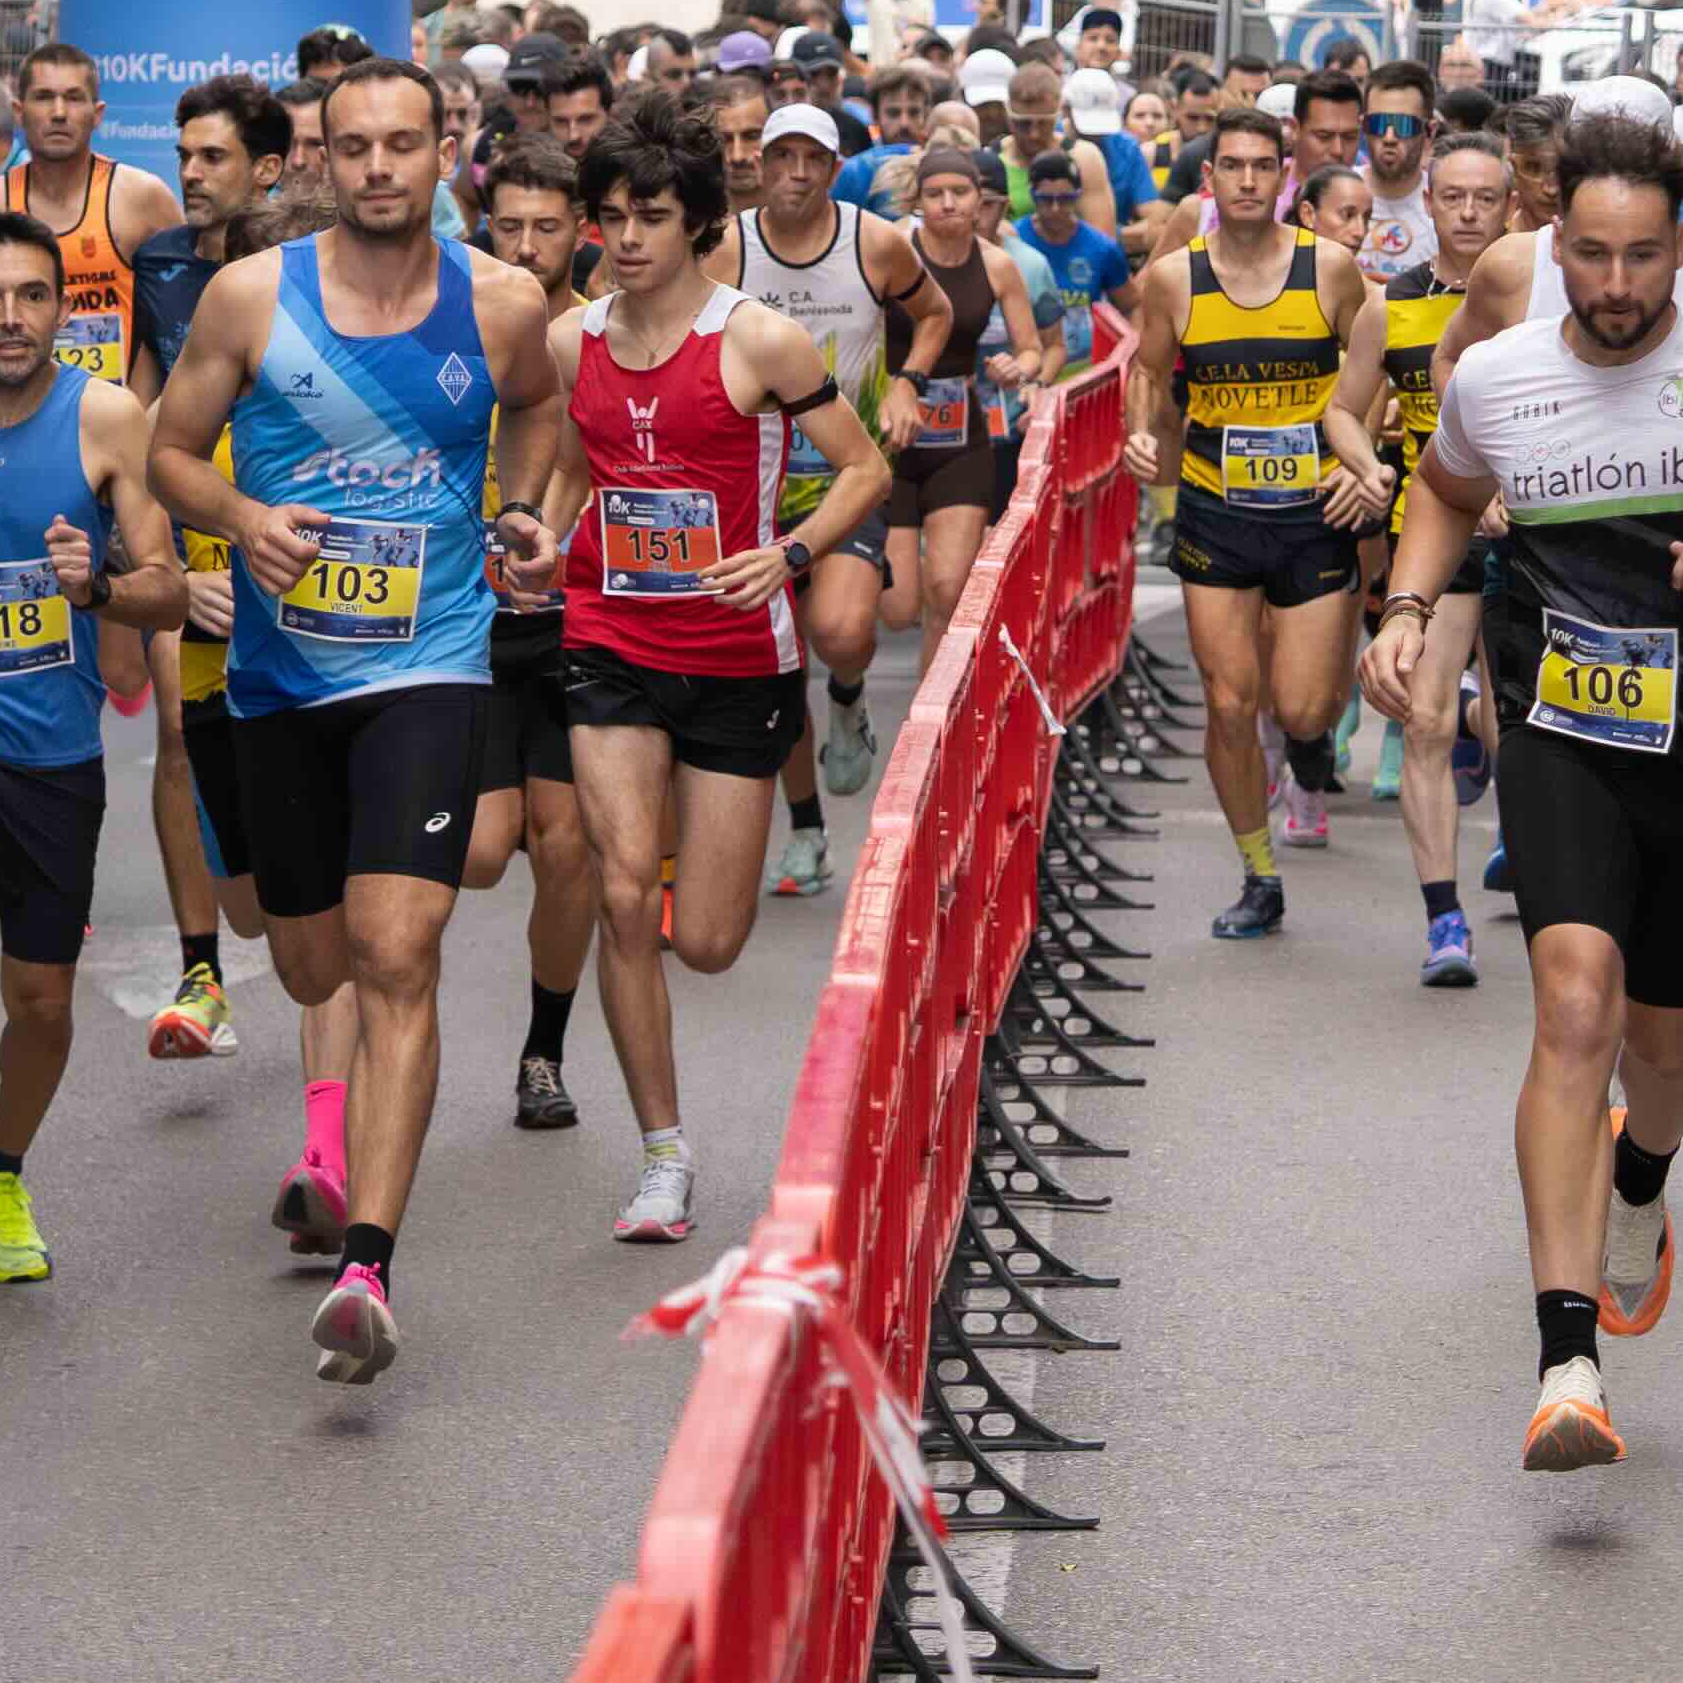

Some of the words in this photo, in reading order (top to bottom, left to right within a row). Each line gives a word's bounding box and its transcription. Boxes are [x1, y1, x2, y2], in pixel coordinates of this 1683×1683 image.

[1245, 458, 1298, 482] 109
[1513, 452, 1647, 501] triatlón
[628, 529, 691, 562] 151
[311, 562, 390, 605] 103
[1550, 627, 1572, 647] 10K
[1563, 666, 1644, 708] 106
